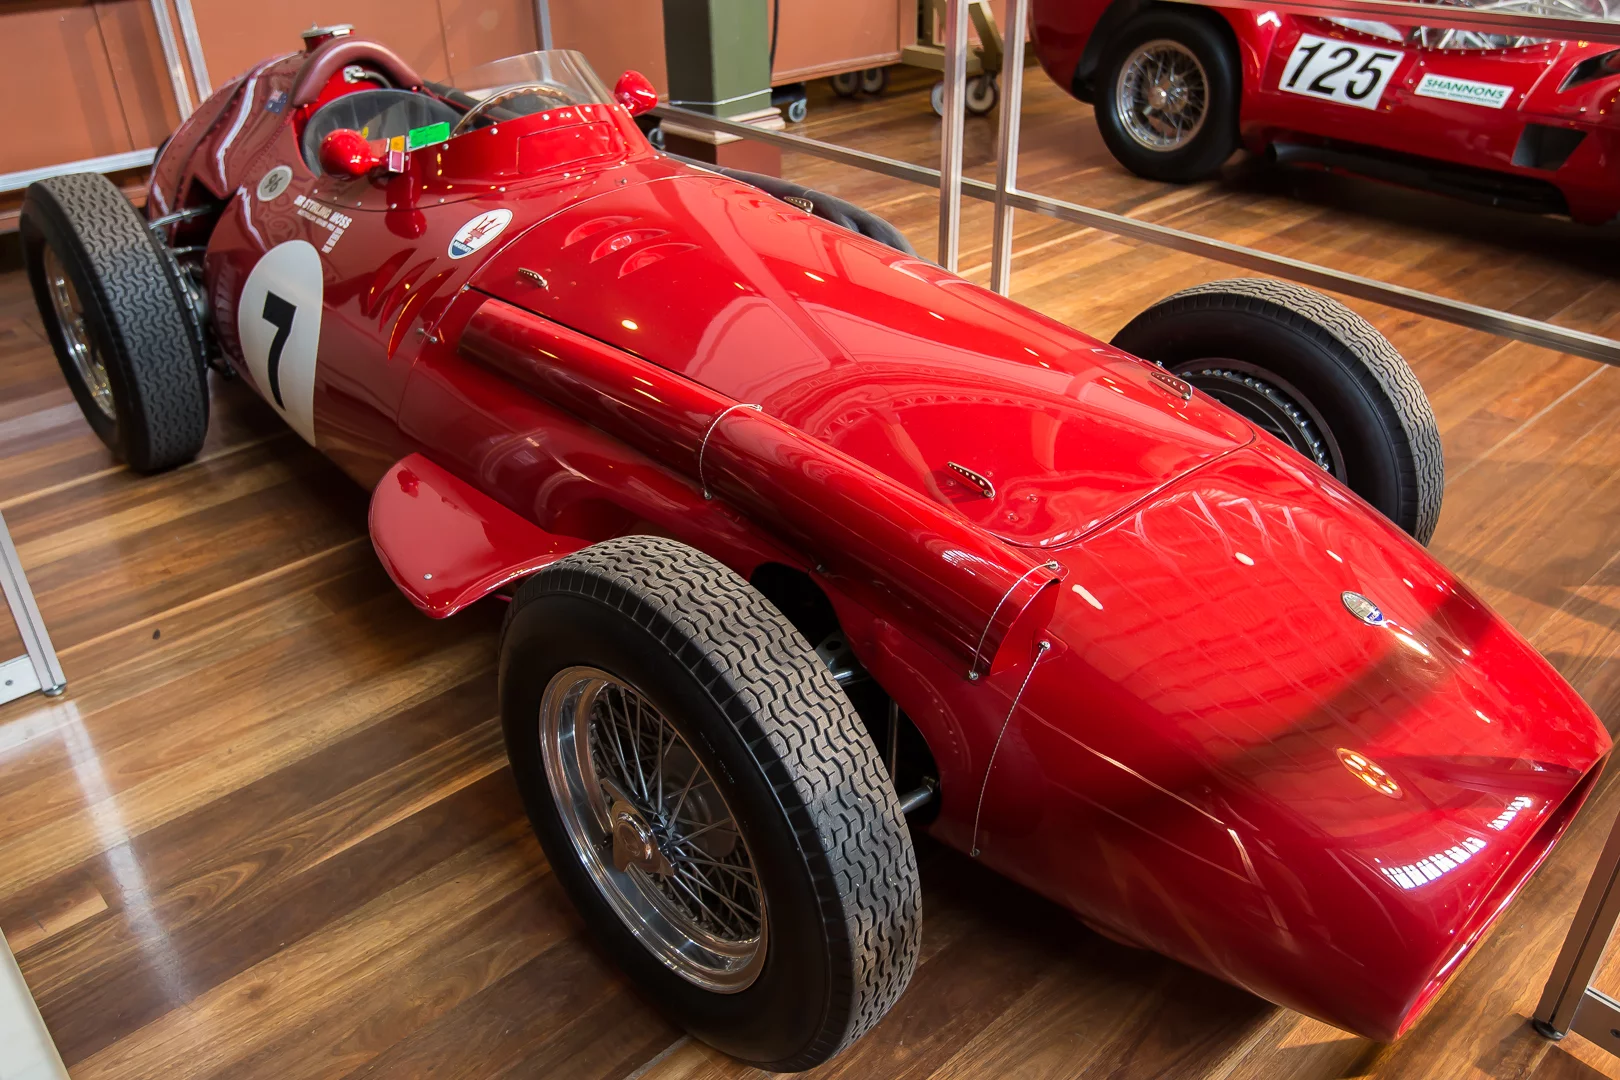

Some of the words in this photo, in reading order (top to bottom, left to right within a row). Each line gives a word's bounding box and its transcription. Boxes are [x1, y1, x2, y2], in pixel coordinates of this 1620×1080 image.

[1286, 42, 1398, 100] 125
[1424, 79, 1505, 98] SHANNONS
[329, 211, 353, 229] MOSS
[262, 290, 297, 412] 7
